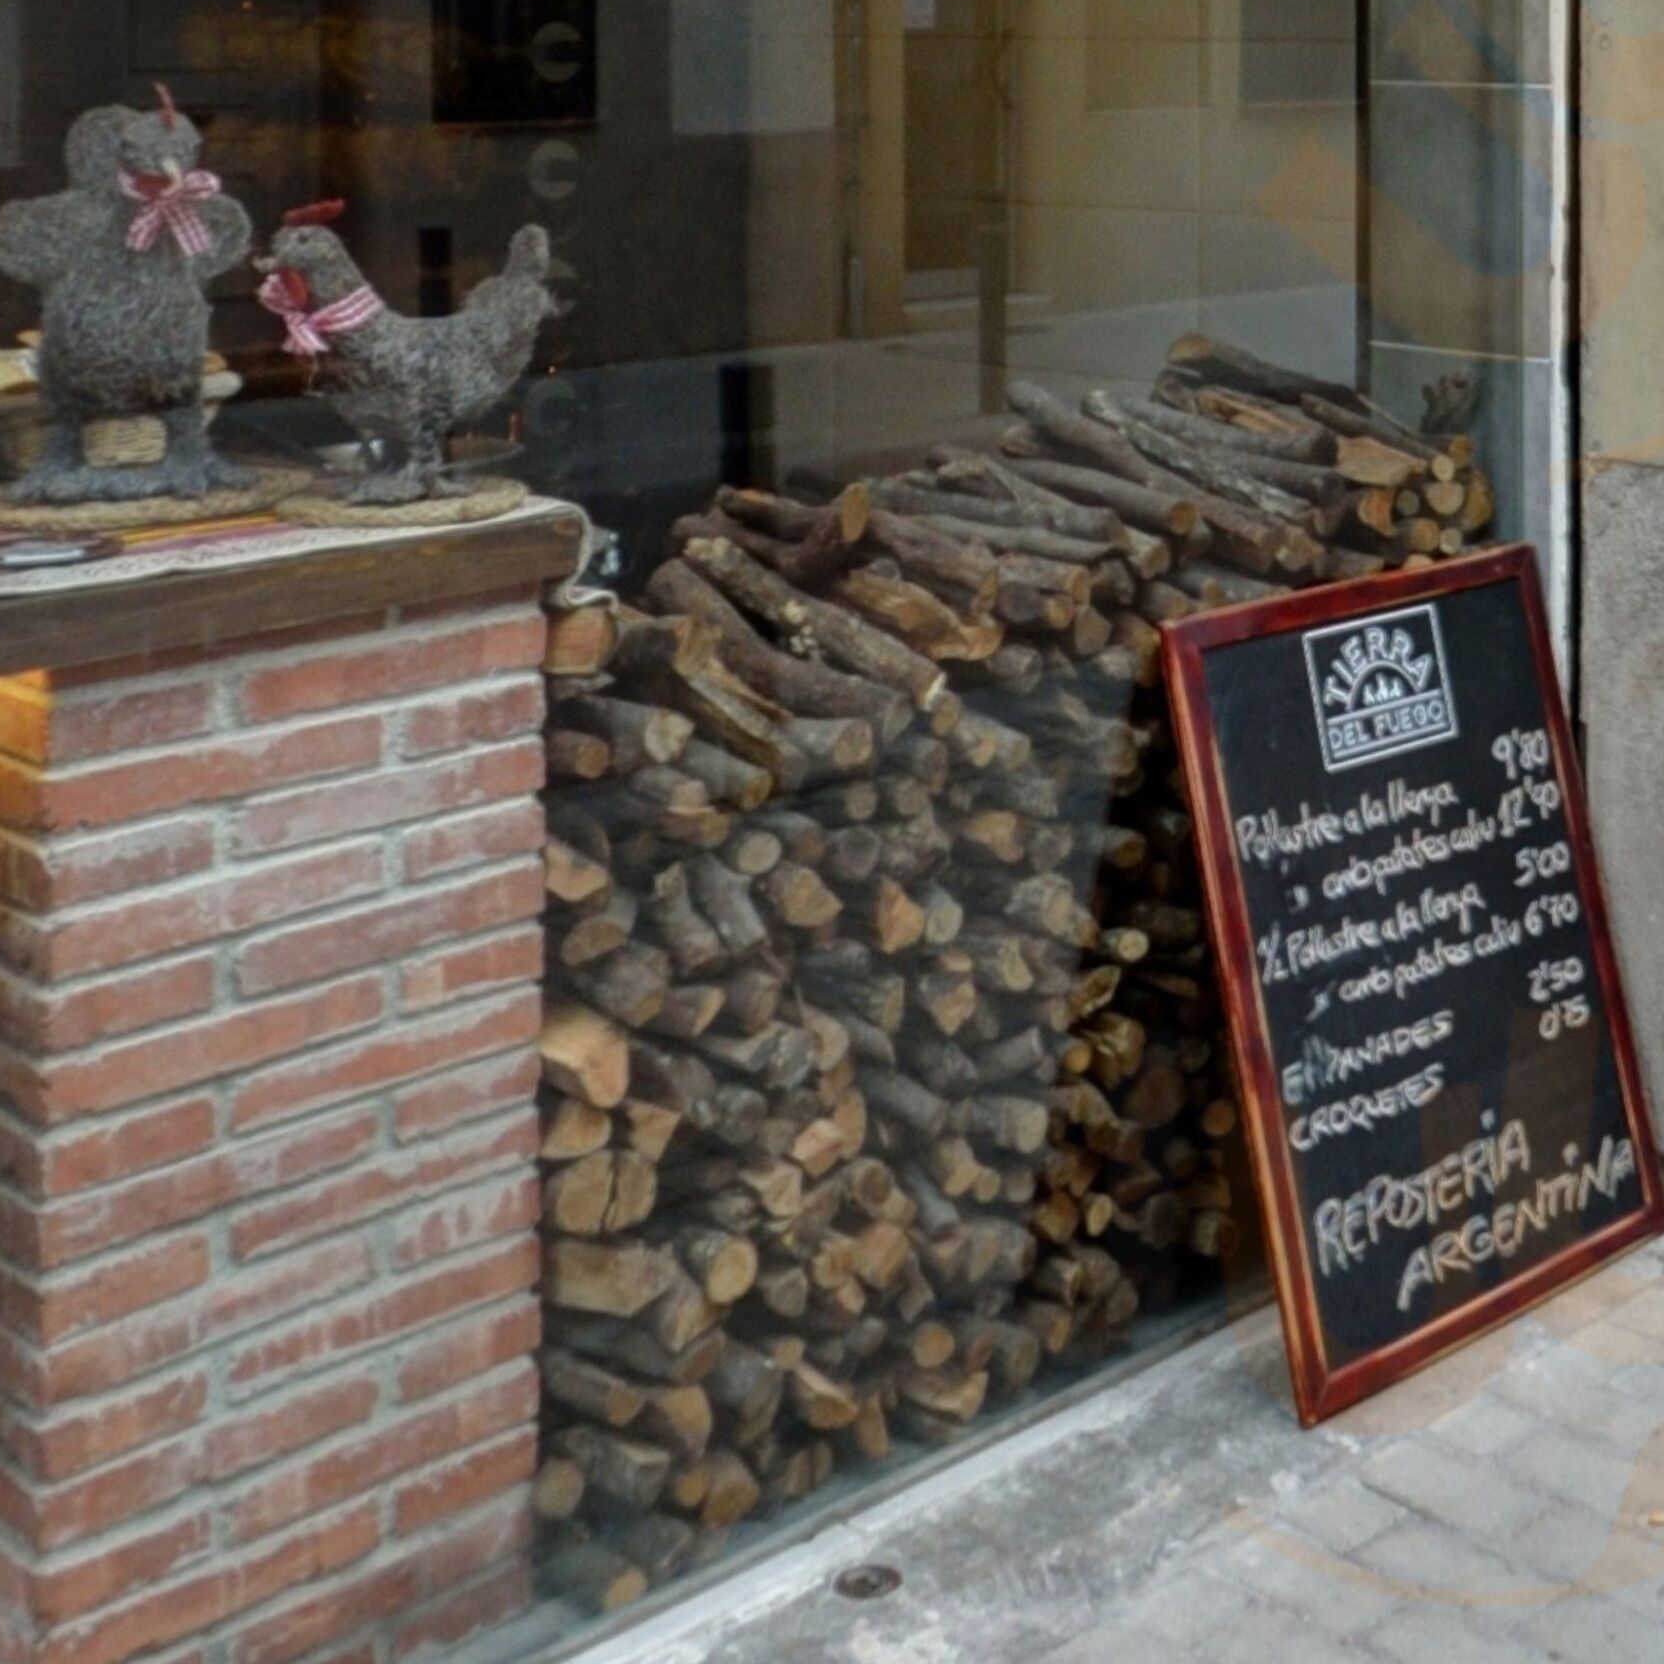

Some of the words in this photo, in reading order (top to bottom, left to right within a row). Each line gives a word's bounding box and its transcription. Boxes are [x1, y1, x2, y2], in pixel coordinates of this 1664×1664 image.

[1323, 626, 1433, 707] TIERRA
[1328, 720, 1371, 750] DEL
[1374, 701, 1445, 738] FUEGO
[1288, 1062, 1445, 1151] CROQUETES
